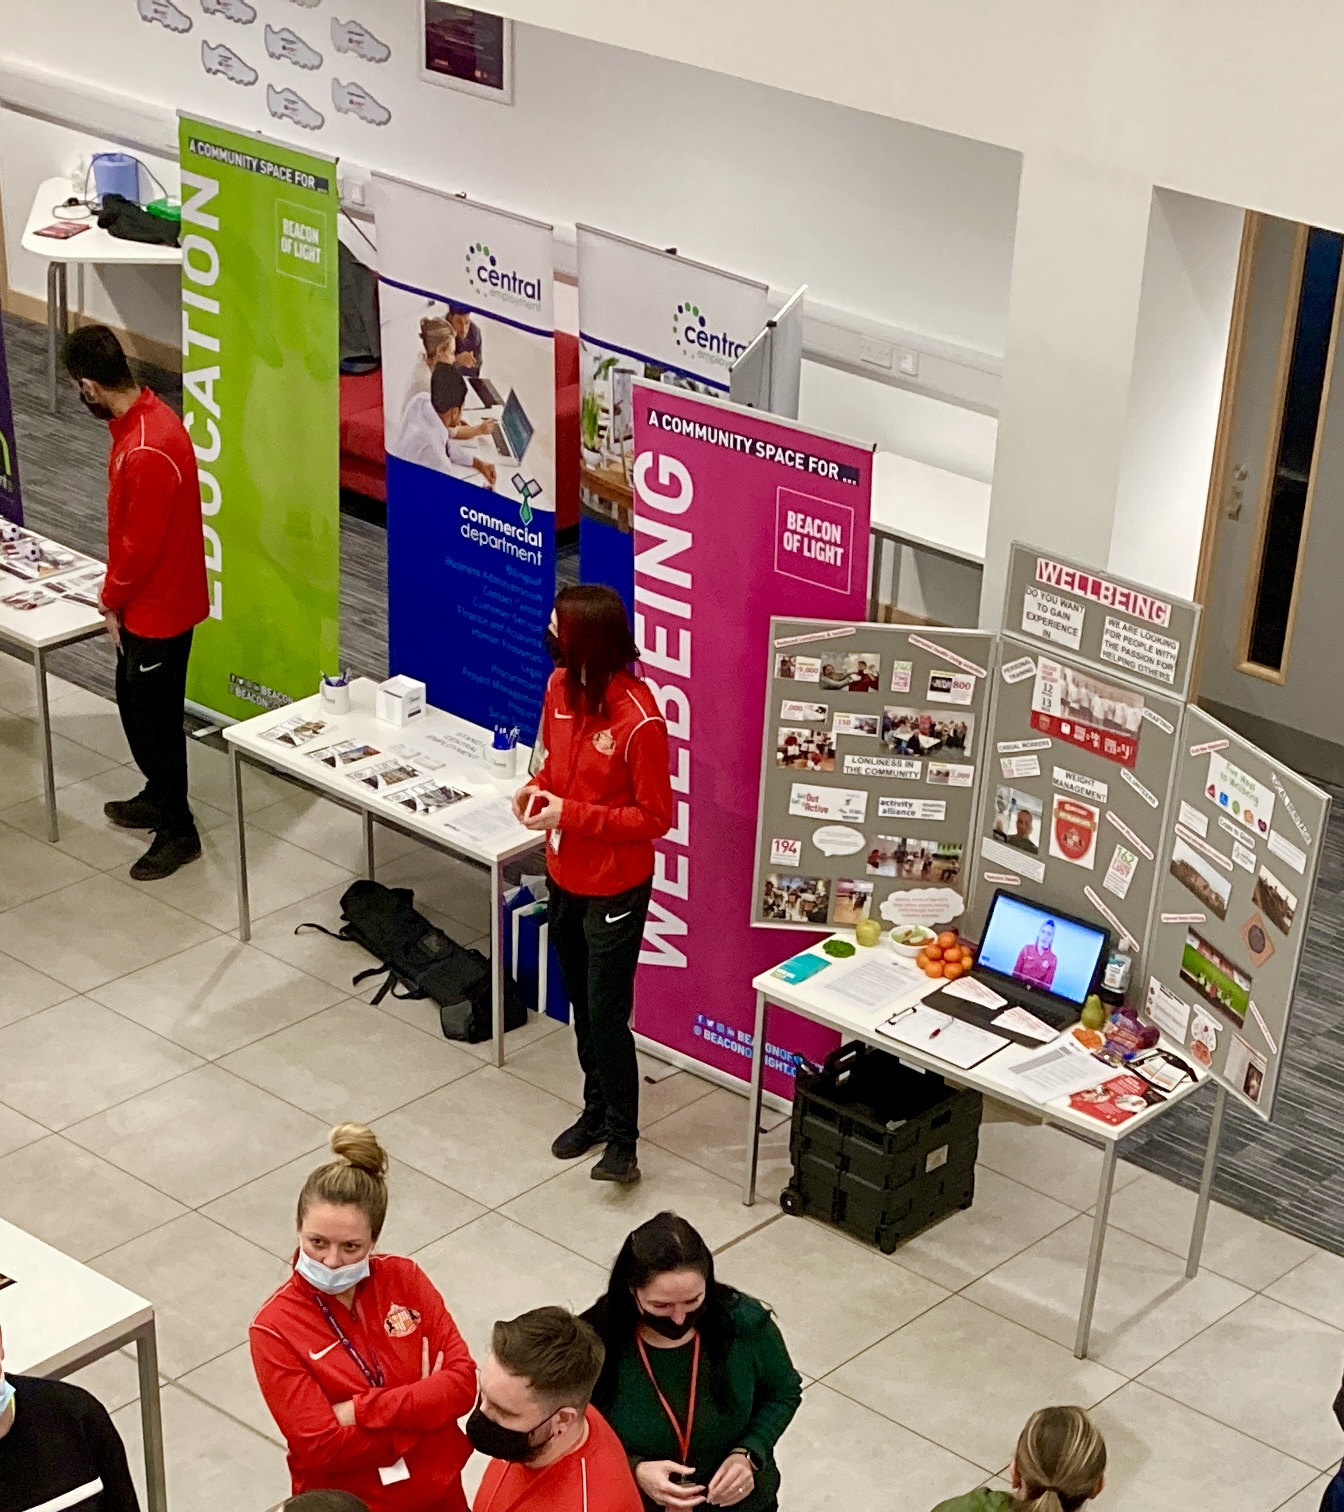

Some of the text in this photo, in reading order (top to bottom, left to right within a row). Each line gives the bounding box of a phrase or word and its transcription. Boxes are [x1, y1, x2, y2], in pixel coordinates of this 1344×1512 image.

[189, 138, 197, 153] A
[197, 141, 259, 172] COMMUNITY
[259, 161, 294, 183] SPACE
[294, 172, 315, 190] FOR
[282, 218, 320, 246] BEACON
[281, 236, 321, 264] OF LIGHT
[477, 263, 542, 302] central
[489, 288, 542, 312] employment
[684, 325, 751, 361] centra
[648, 410, 659, 428] A
[661, 414, 754, 455] COMMUNITY
[754, 441, 805, 471] SPACE
[808, 456, 840, 480] FOR
[459, 505, 543, 548] commercial
[786, 510, 842, 545] BEACON
[460, 523, 543, 566] department
[782, 531, 845, 568] OF LIGHT
[1025, 586, 1085, 614] DO YOU WANT
[1038, 559, 1168, 626] WELLBEING
[1026, 611, 1079, 637] EXPERIENCE
[1037, 602, 1072, 622] TO GAIN
[1042, 629, 1052, 640] IN
[1104, 629, 1177, 662] FOR PEOPLE WITH
[1107, 618, 1178, 651] WE ARE LOOKING
[1003, 657, 1032, 675] PERSONAL
[1102, 649, 1172, 682] HELPING OTHERS
[1104, 639, 1174, 671] THE PASSION FOR
[952, 681, 972, 691] 800
[1009, 667, 1034, 681] TRAINING
[845, 766, 920, 779] THE COMMUNITY
[851, 756, 914, 769] LONLINESS IN
[1052, 778, 1107, 803] MANAGEMENT
[1065, 771, 1096, 788] WEIGHT
[1122, 770, 1157, 805] VOLUNTEERS
[880, 799, 914, 809] activity
[881, 807, 916, 817] alliance
[773, 839, 798, 855] 194
